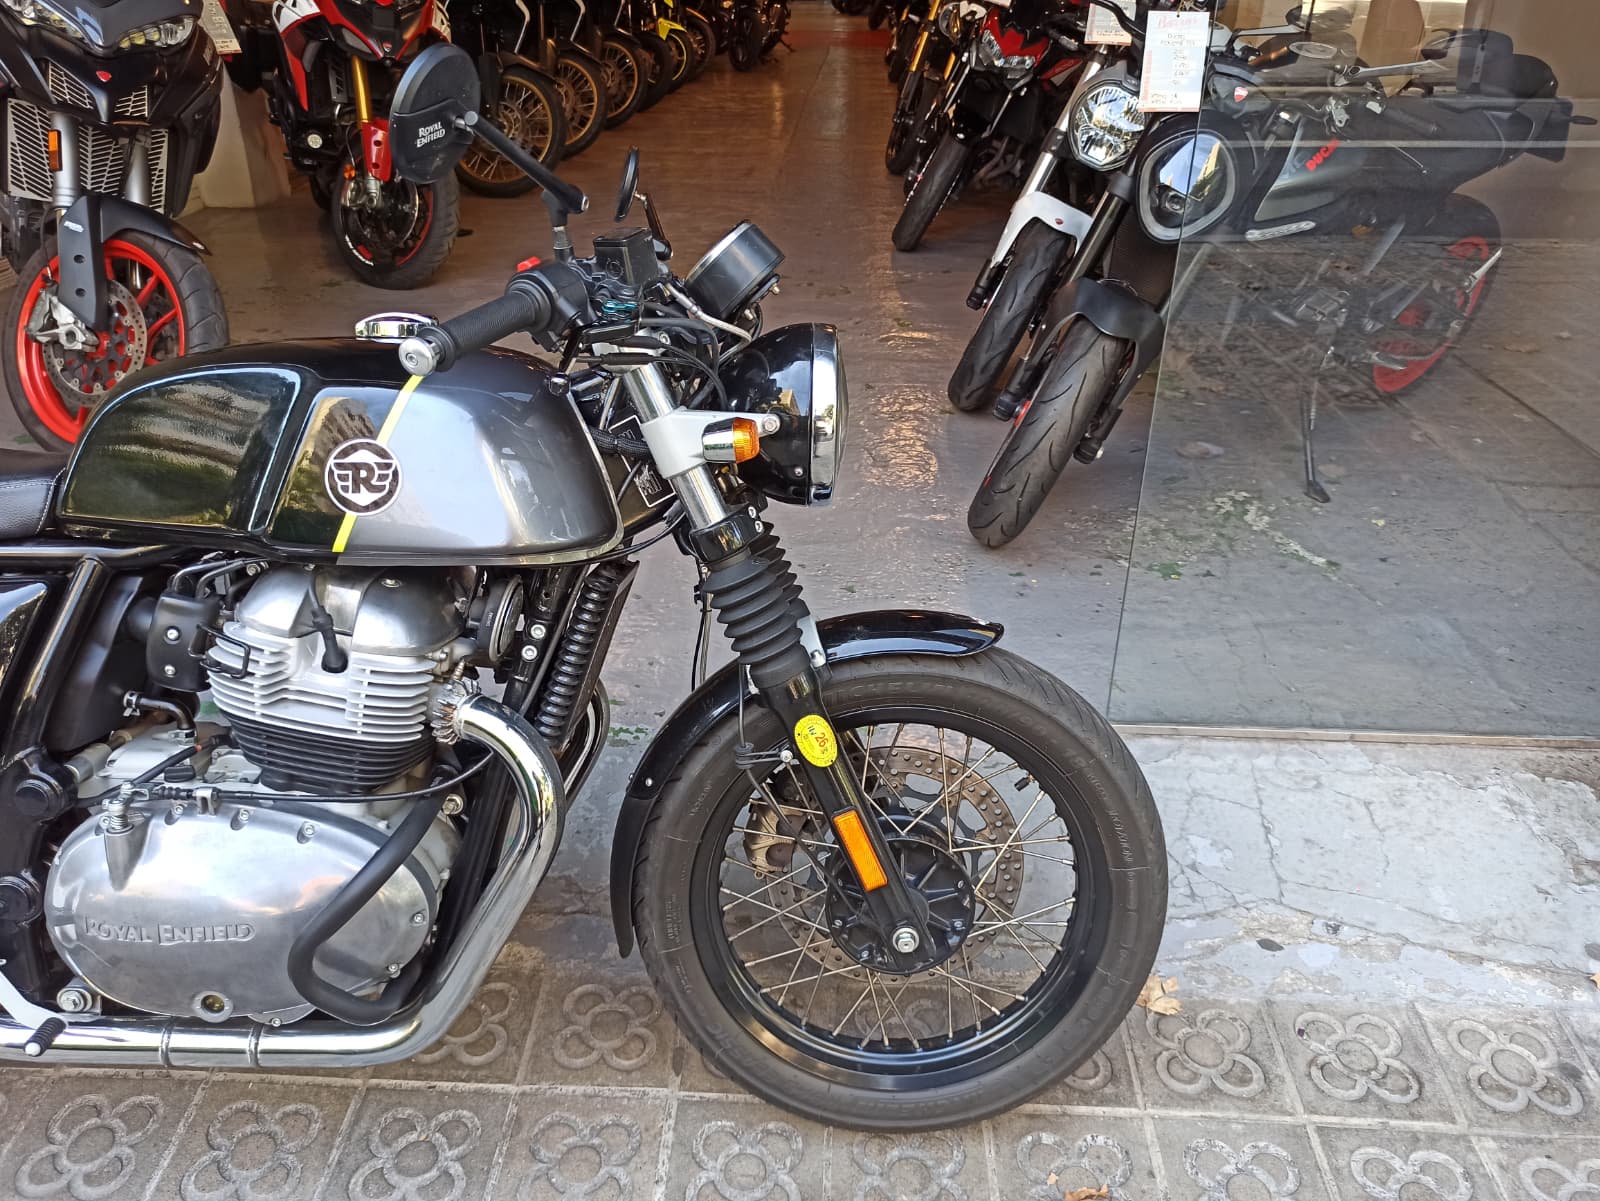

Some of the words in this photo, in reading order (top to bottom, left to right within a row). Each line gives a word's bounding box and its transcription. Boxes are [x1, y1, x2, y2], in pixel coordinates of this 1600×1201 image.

[419, 121, 442, 137] ROYAL
[416, 129, 445, 148] ENFIELD
[815, 732, 829, 748] 26
[85, 915, 153, 942] ROYAL
[157, 922, 256, 946] ENFIELD
